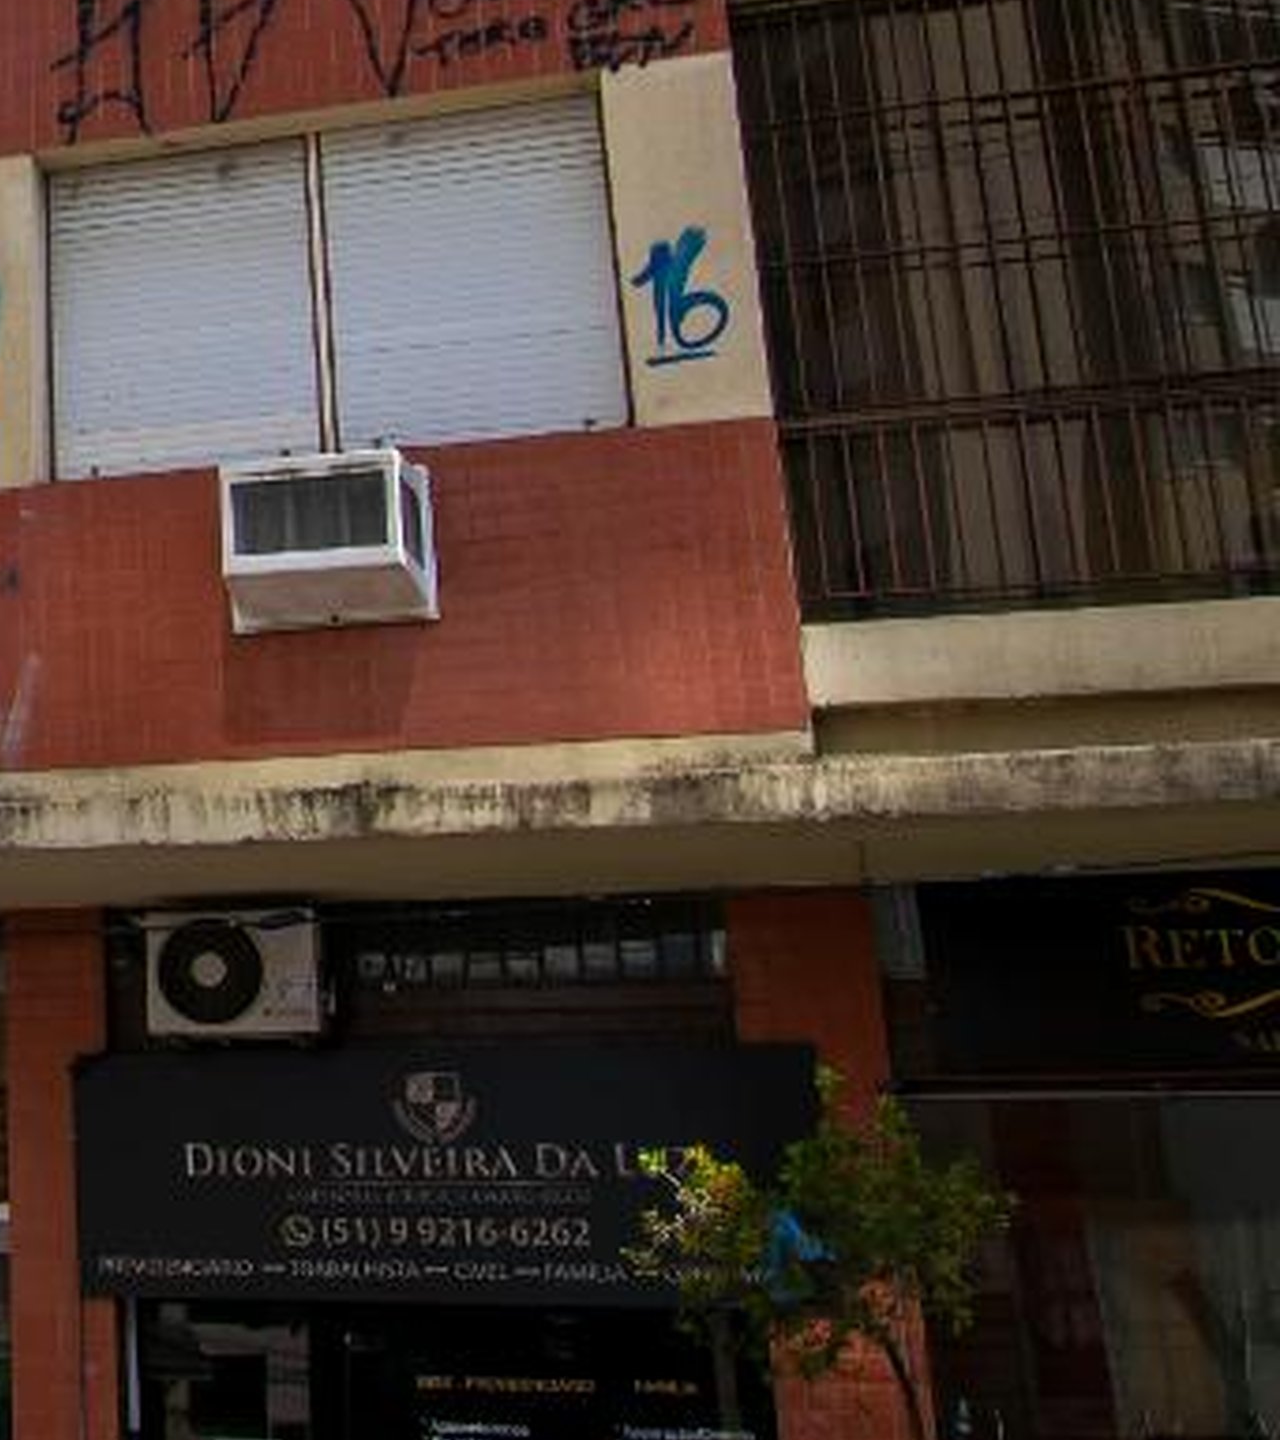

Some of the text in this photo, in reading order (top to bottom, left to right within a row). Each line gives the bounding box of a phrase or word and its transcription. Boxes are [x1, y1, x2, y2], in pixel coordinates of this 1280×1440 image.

[632, 225, 729, 353] 16
[329, 1140, 518, 1179] SILVEIRA
[321, 1216, 591, 1249] (51) 9 9216-6262
